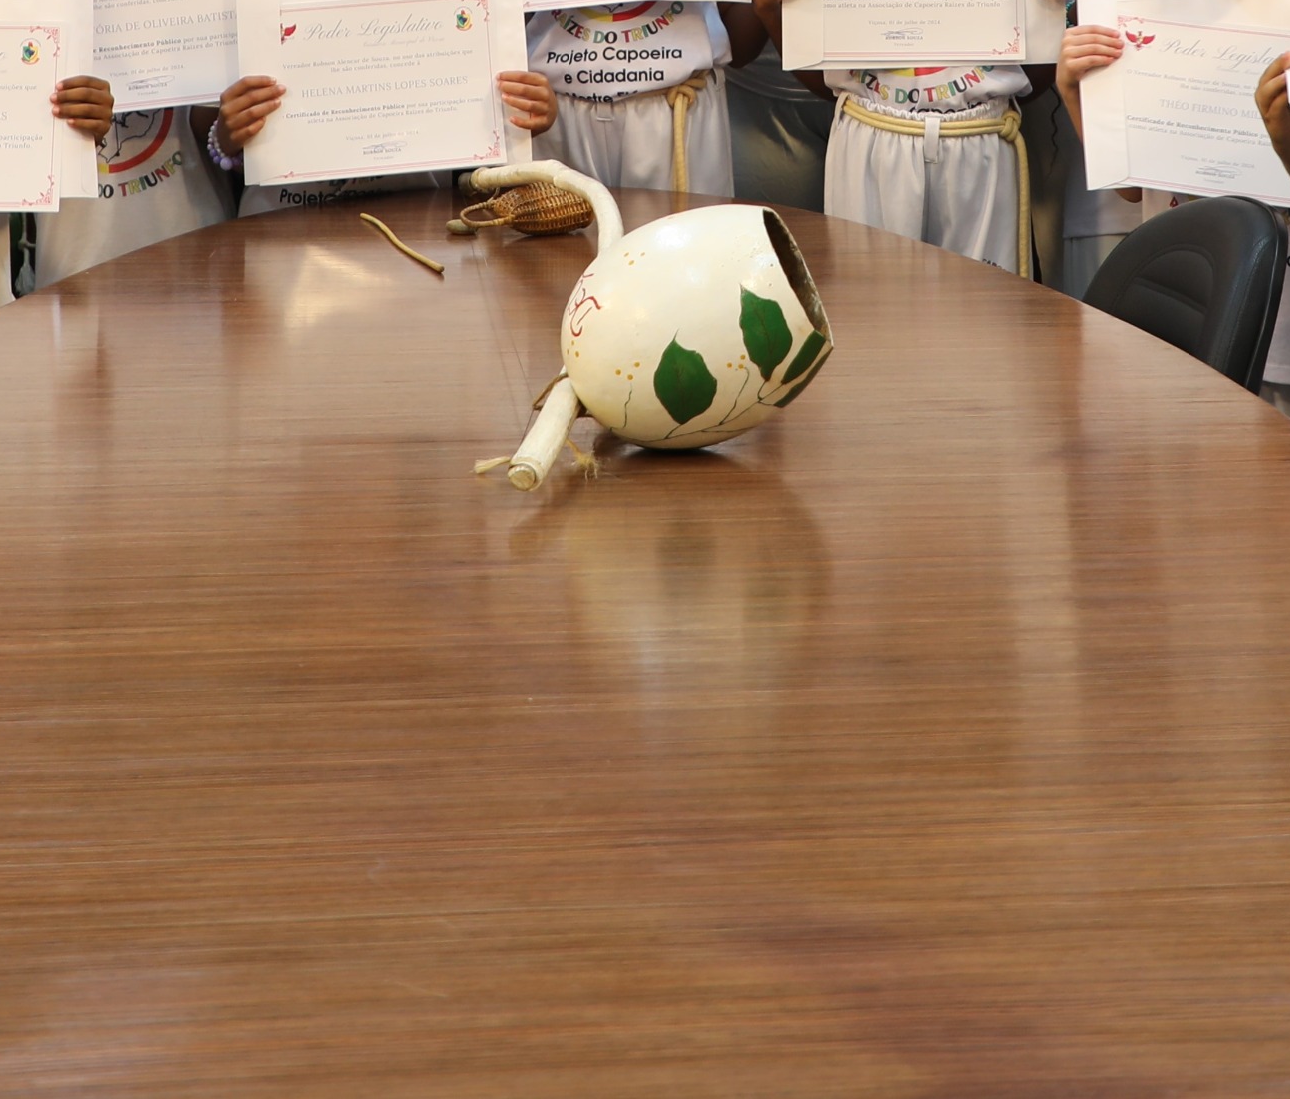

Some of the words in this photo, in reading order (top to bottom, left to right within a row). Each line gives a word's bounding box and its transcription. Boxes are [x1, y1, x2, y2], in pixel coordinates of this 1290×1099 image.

[303, 19, 350, 41] Poder
[358, 13, 443, 42] Legislativo
[551, 9, 591, 42] RAÍZES
[593, 30, 618, 44] DO
[621, 1, 684, 43] TRIUNFO
[547, 49, 598, 64] Projeto
[602, 46, 682, 63] Capoeira
[301, 87, 343, 99] HELENA
[345, 82, 393, 96] MARTINS
[394, 79, 427, 90] LOPES
[428, 75, 468, 88] SOARES
[564, 73, 572, 84] e
[576, 68, 665, 84] Cidadania
[118, 155, 184, 198] TRIUNFO
